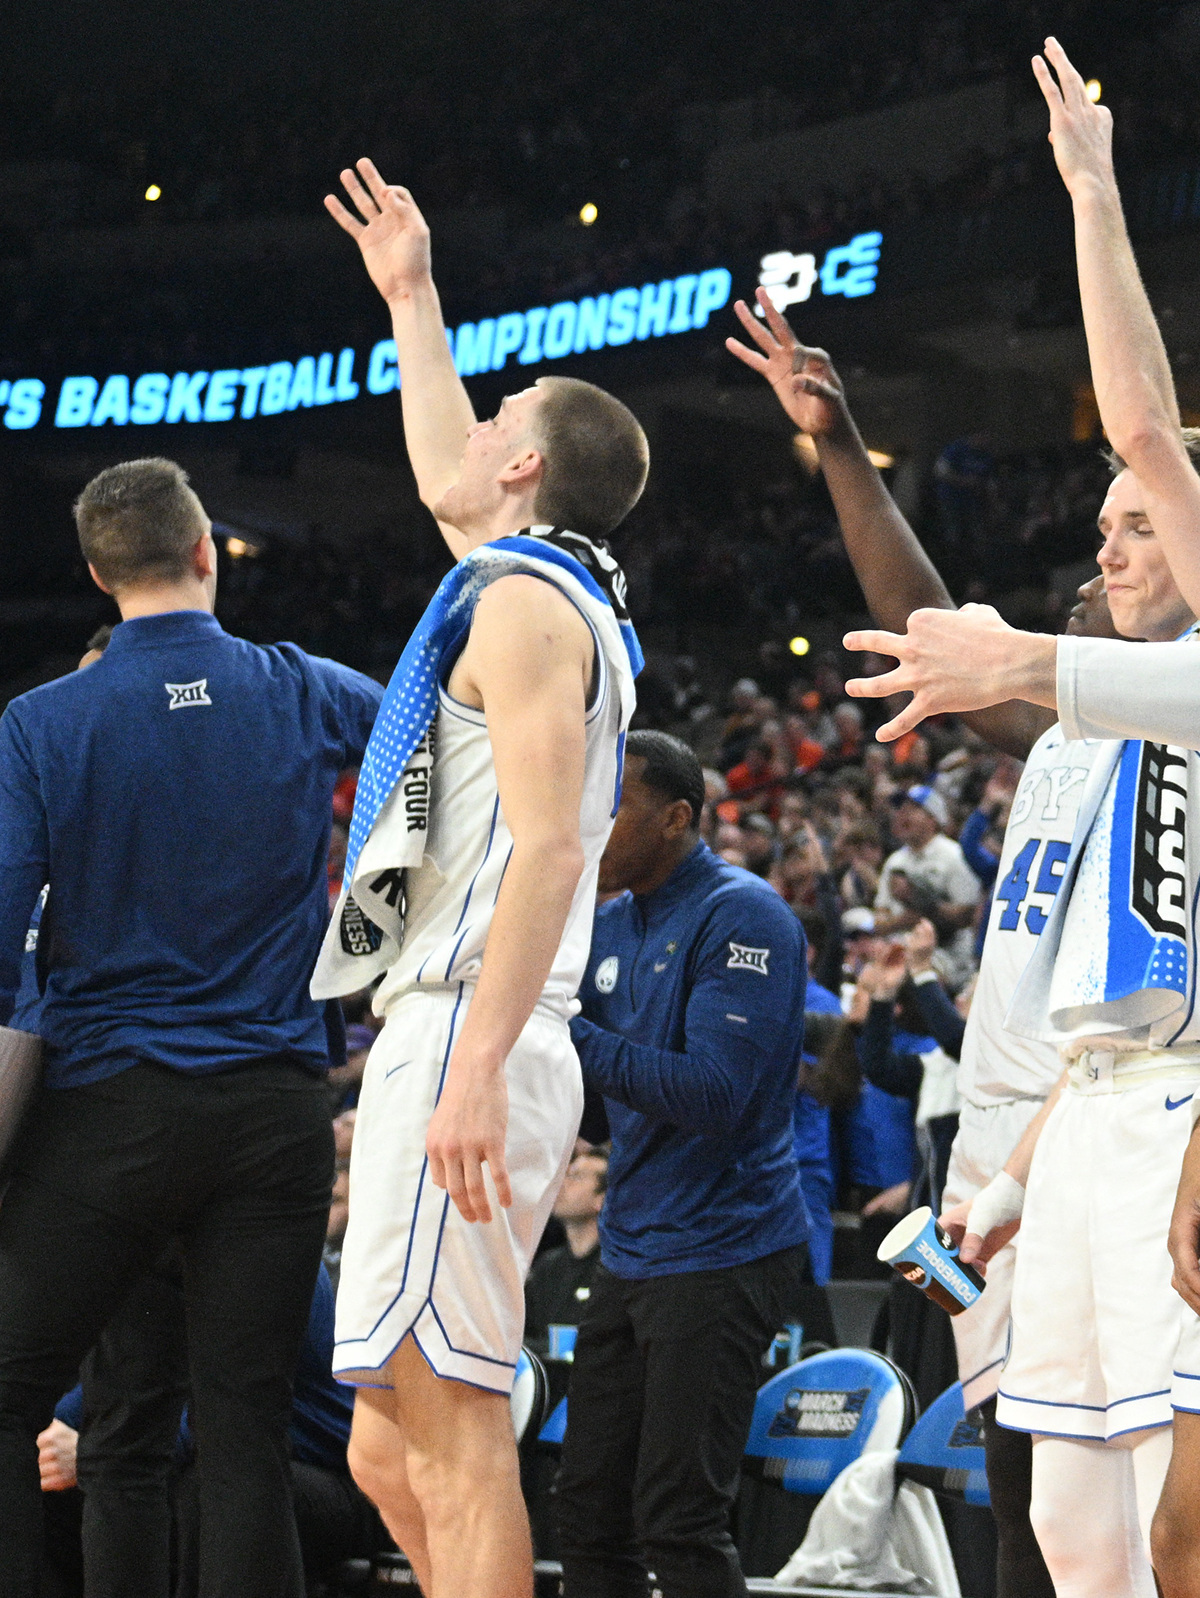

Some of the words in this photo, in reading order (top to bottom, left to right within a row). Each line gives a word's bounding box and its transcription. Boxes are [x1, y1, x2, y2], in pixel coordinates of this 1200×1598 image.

[54, 347, 359, 429] BASKETBALL
[366, 266, 733, 396] CMPIONSHIP
[172, 686, 204, 704] XII
[403, 767, 429, 834] FOUR
[1010, 766, 1088, 830] BY
[996, 837, 1072, 936] 45
[732, 949, 763, 968] XII
[914, 1239, 978, 1304] POWERADE
[796, 1411, 861, 1431] MADNESS
[797, 1391, 848, 1411] MARCH
